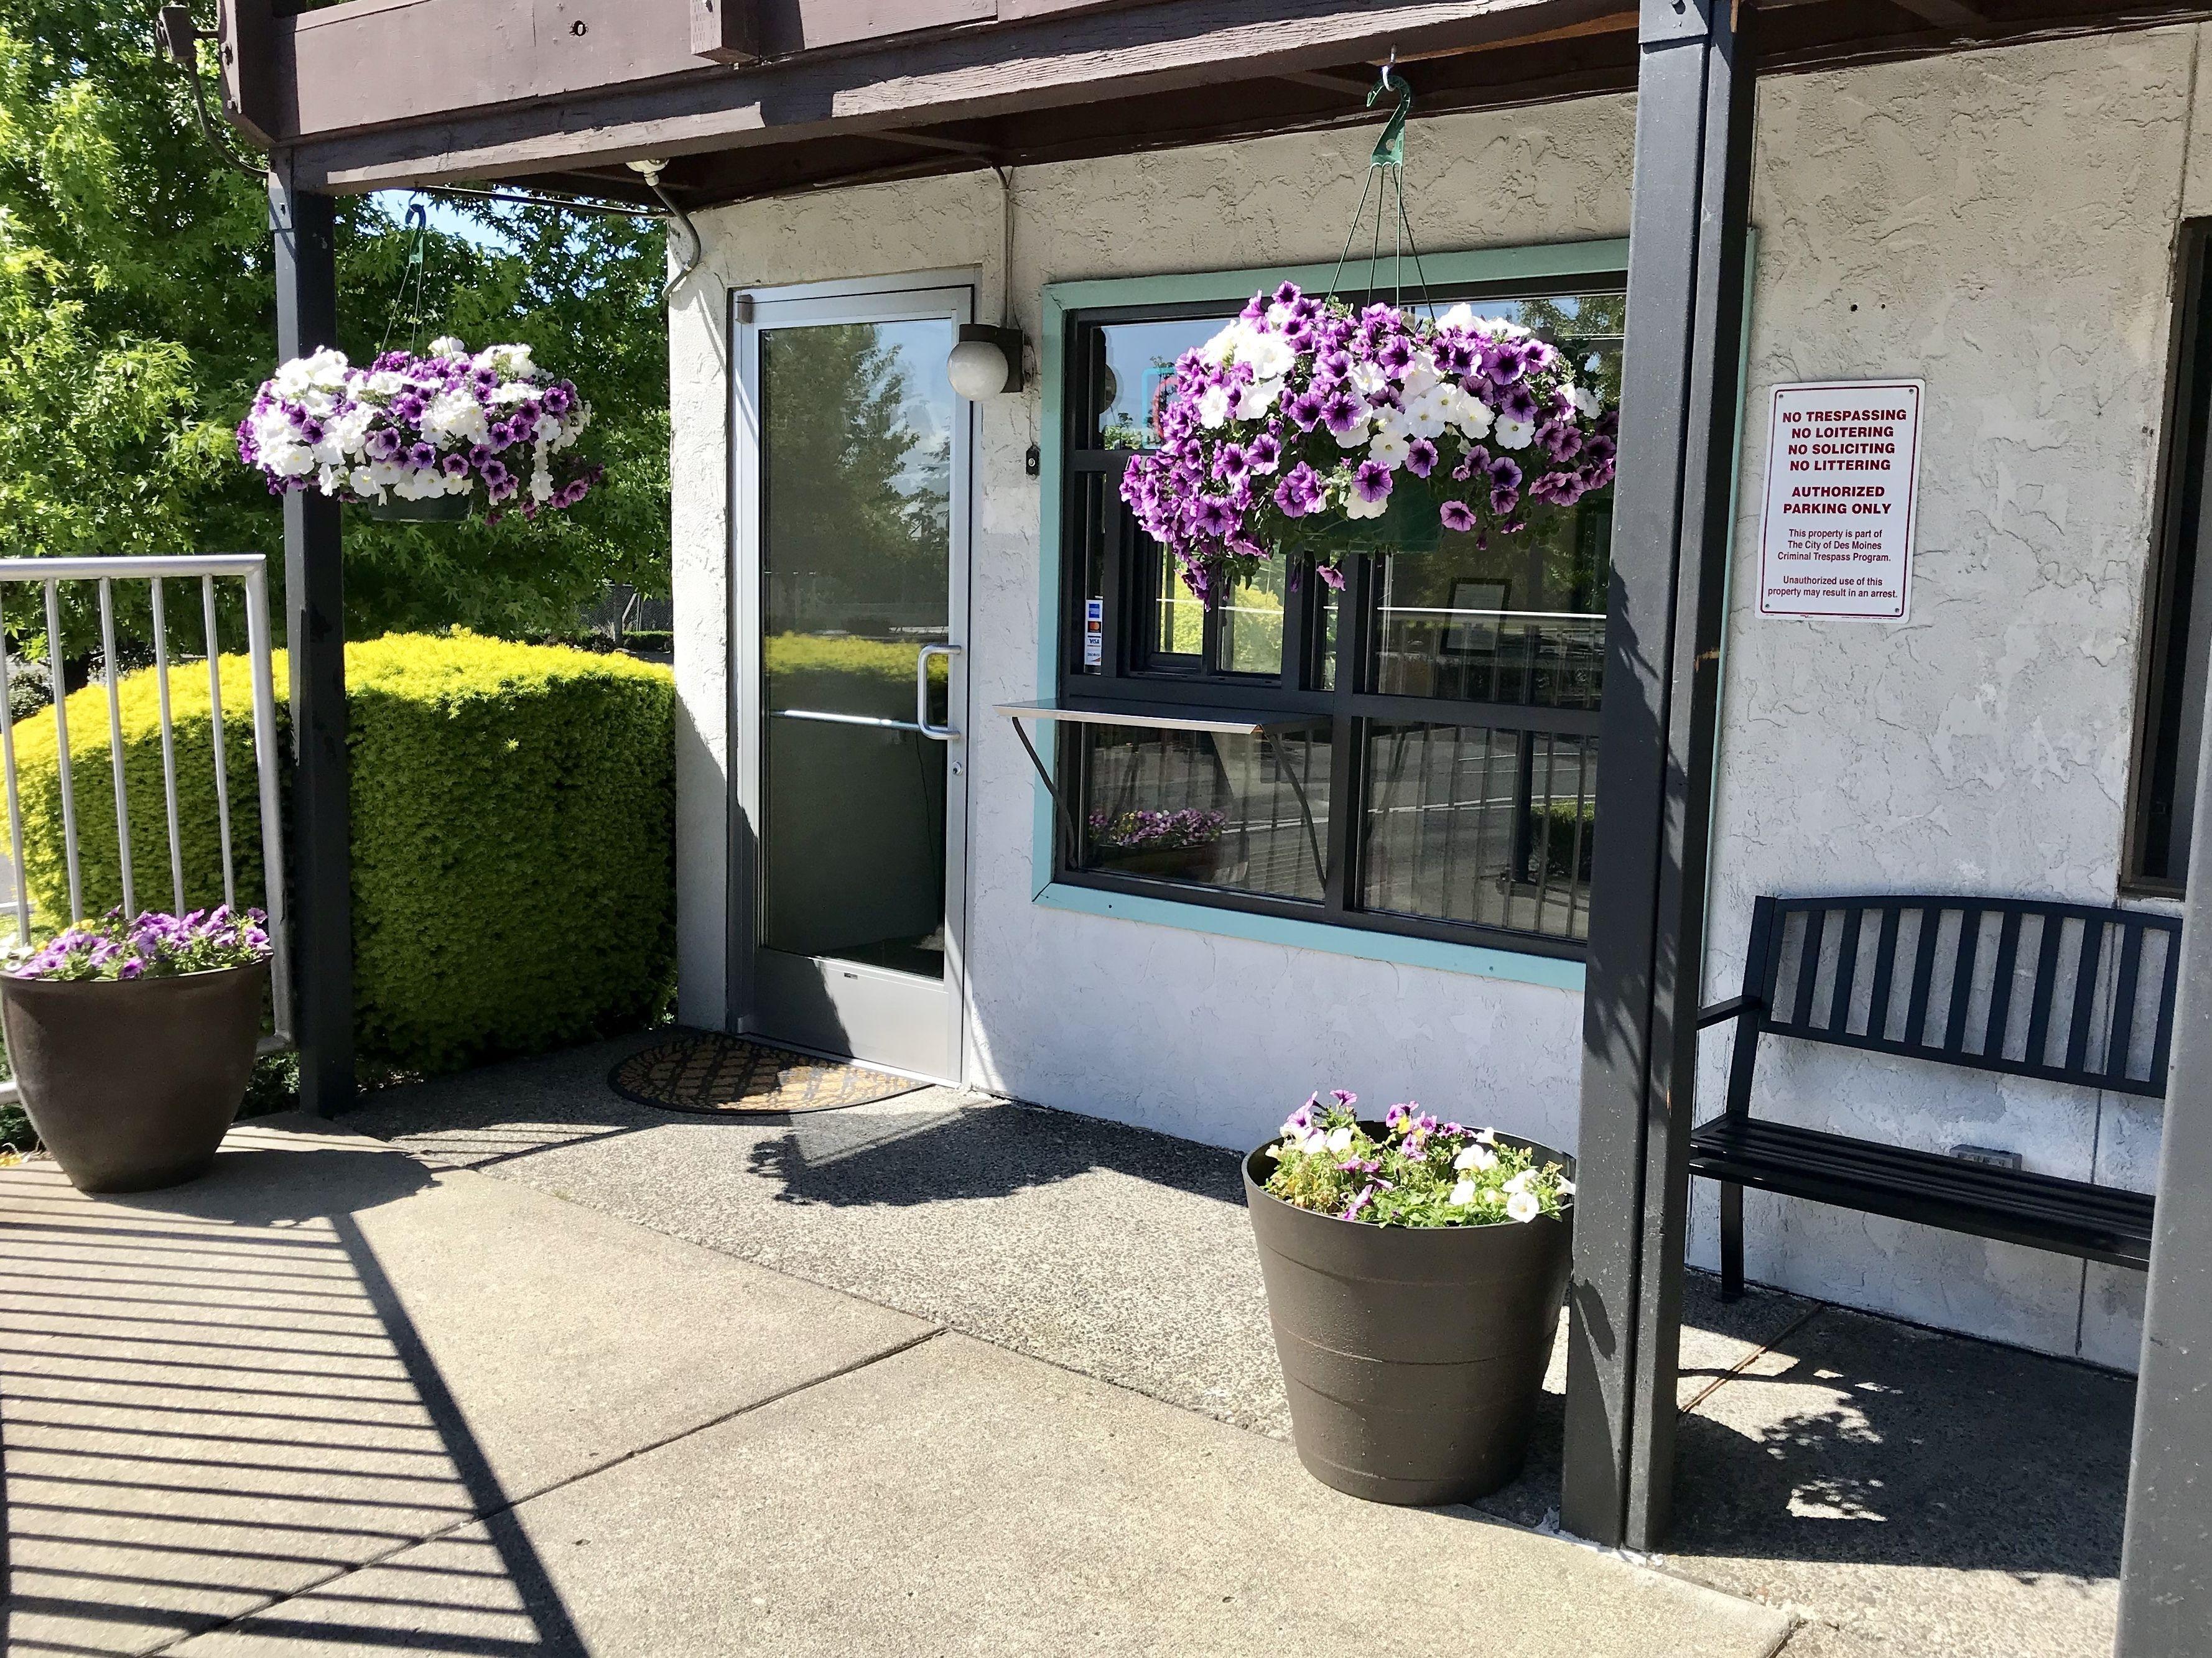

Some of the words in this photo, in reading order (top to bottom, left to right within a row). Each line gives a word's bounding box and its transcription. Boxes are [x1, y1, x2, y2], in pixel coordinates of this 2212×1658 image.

[1783, 412, 1801, 422] NO
[1806, 409, 1906, 422] TRESPASSING
[1792, 428, 1811, 438] NO
[1816, 427, 1894, 438] LOITERING
[1788, 444, 1808, 455] NO
[1813, 443, 1895, 454] SOLICITING
[1790, 460, 1810, 471] NO
[1815, 460, 1890, 471] LITTERING
[1792, 486, 1884, 497] AUTHORIZED
[1783, 504, 1846, 514] PARKING
[1852, 504, 1891, 514] ONLY
[1789, 529, 1806, 537] This
[1808, 530, 1843, 539] property
[1846, 529, 1852, 537] is
[1855, 530, 1872, 539] part
[1788, 540, 1803, 549] The
[1805, 540, 1821, 550] City
[1834, 541, 1849, 549] Des
[1852, 541, 1881, 549] Moines
[1778, 552, 1811, 560] Criminal
[1813, 552, 1850, 562] Trespass
[1853, 553, 1890, 563] Program.
[1783, 576, 1837, 585] Unauthorized
[1857, 577, 1865, 585] of
[1867, 578, 1882, 586] this
[1768, 589, 1801, 598] property
[1804, 590, 1820, 598] may
[1823, 588, 1846, 596] result
